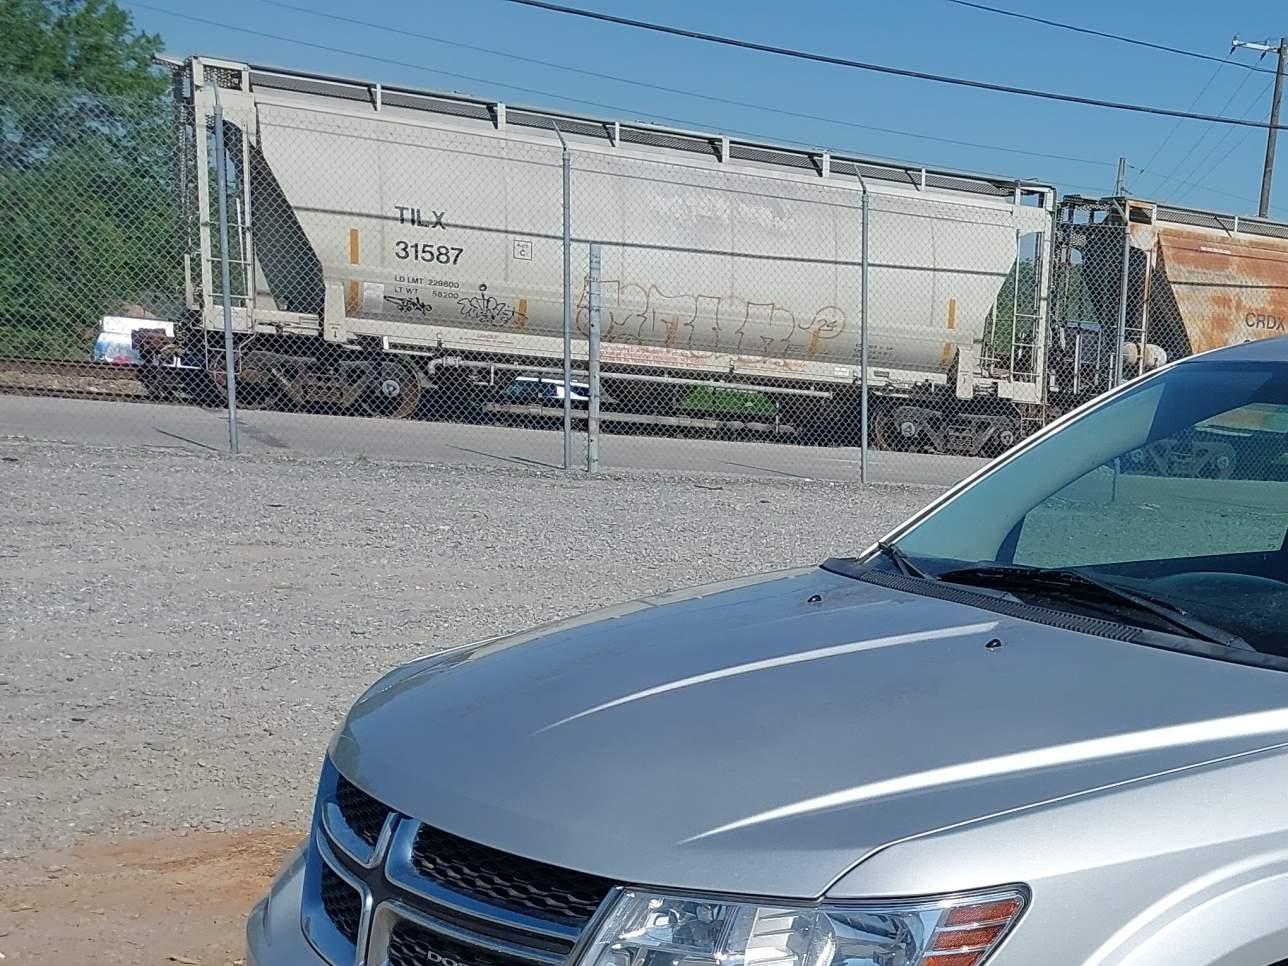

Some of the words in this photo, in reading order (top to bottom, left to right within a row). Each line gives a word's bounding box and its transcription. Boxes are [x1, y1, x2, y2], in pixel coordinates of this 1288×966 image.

[395, 205, 447, 230] TILX
[395, 240, 464, 265] 31587
[394, 275, 406, 283] LD
[407, 276, 424, 285] LMT
[394, 286, 404, 294] LT
[405, 287, 420, 295] WT
[1245, 311, 1286, 331] CRDX
